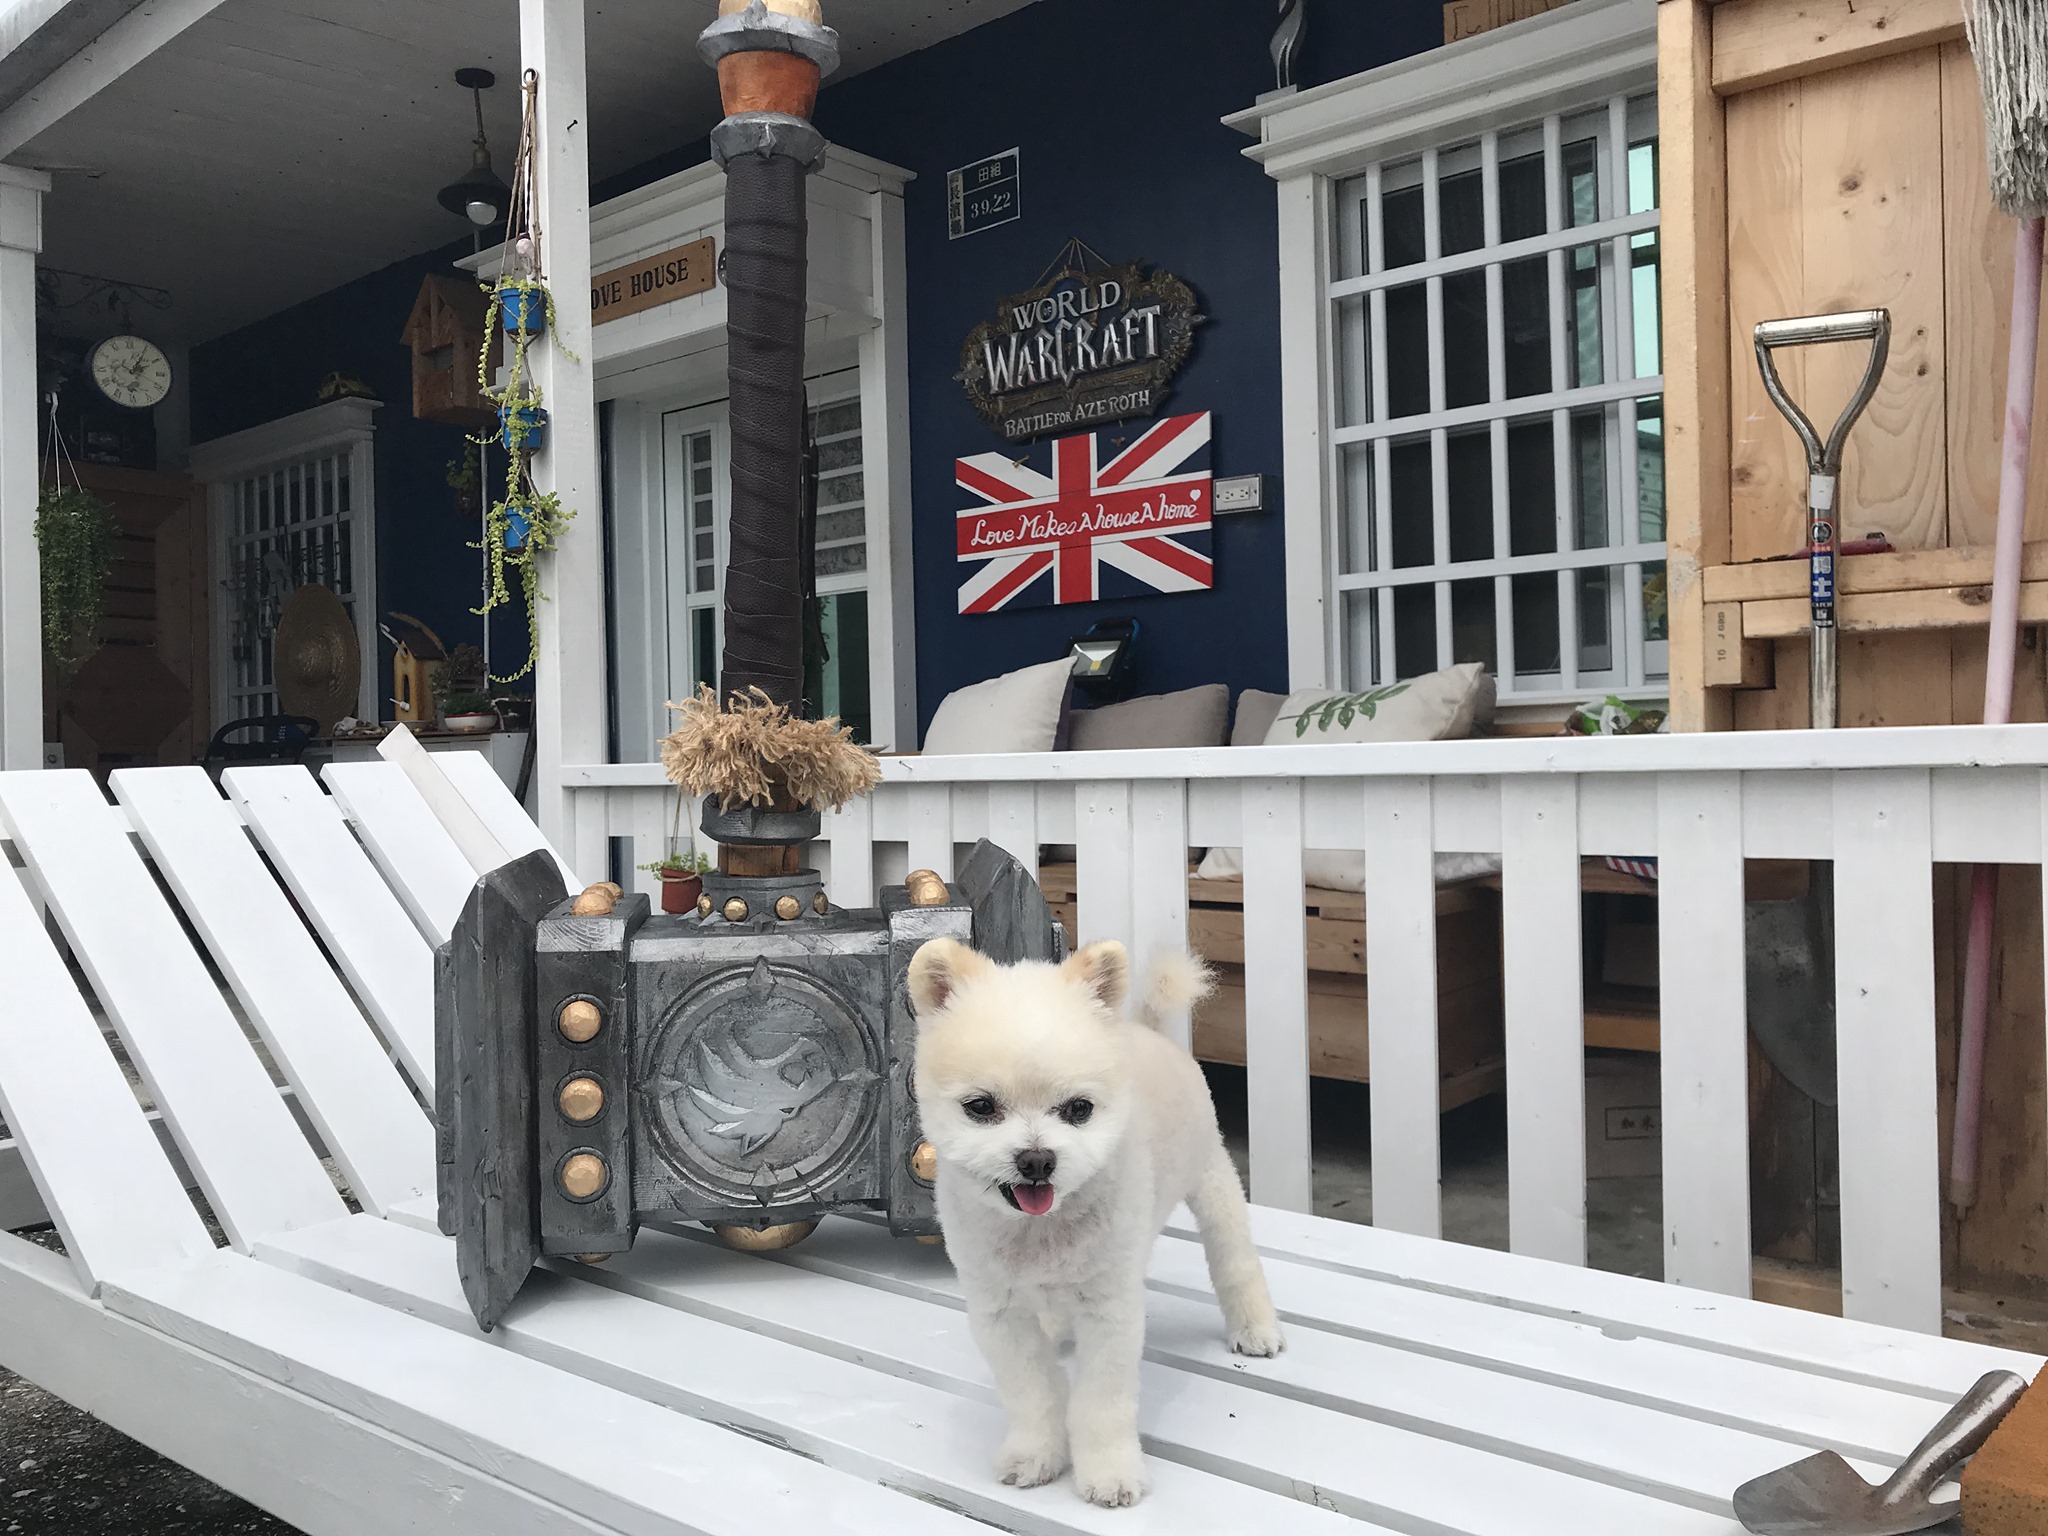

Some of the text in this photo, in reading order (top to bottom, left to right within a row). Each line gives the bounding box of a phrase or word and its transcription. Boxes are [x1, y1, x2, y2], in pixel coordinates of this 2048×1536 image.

[591, 258, 689, 310] OVE HOUSE
[1012, 281, 1121, 330] WORLD
[984, 305, 1161, 394] WARCRAFT
[1005, 389, 1151, 437] BATTLE FOR AZEROTH
[970, 493, 1199, 547] Love Makes A house A home
